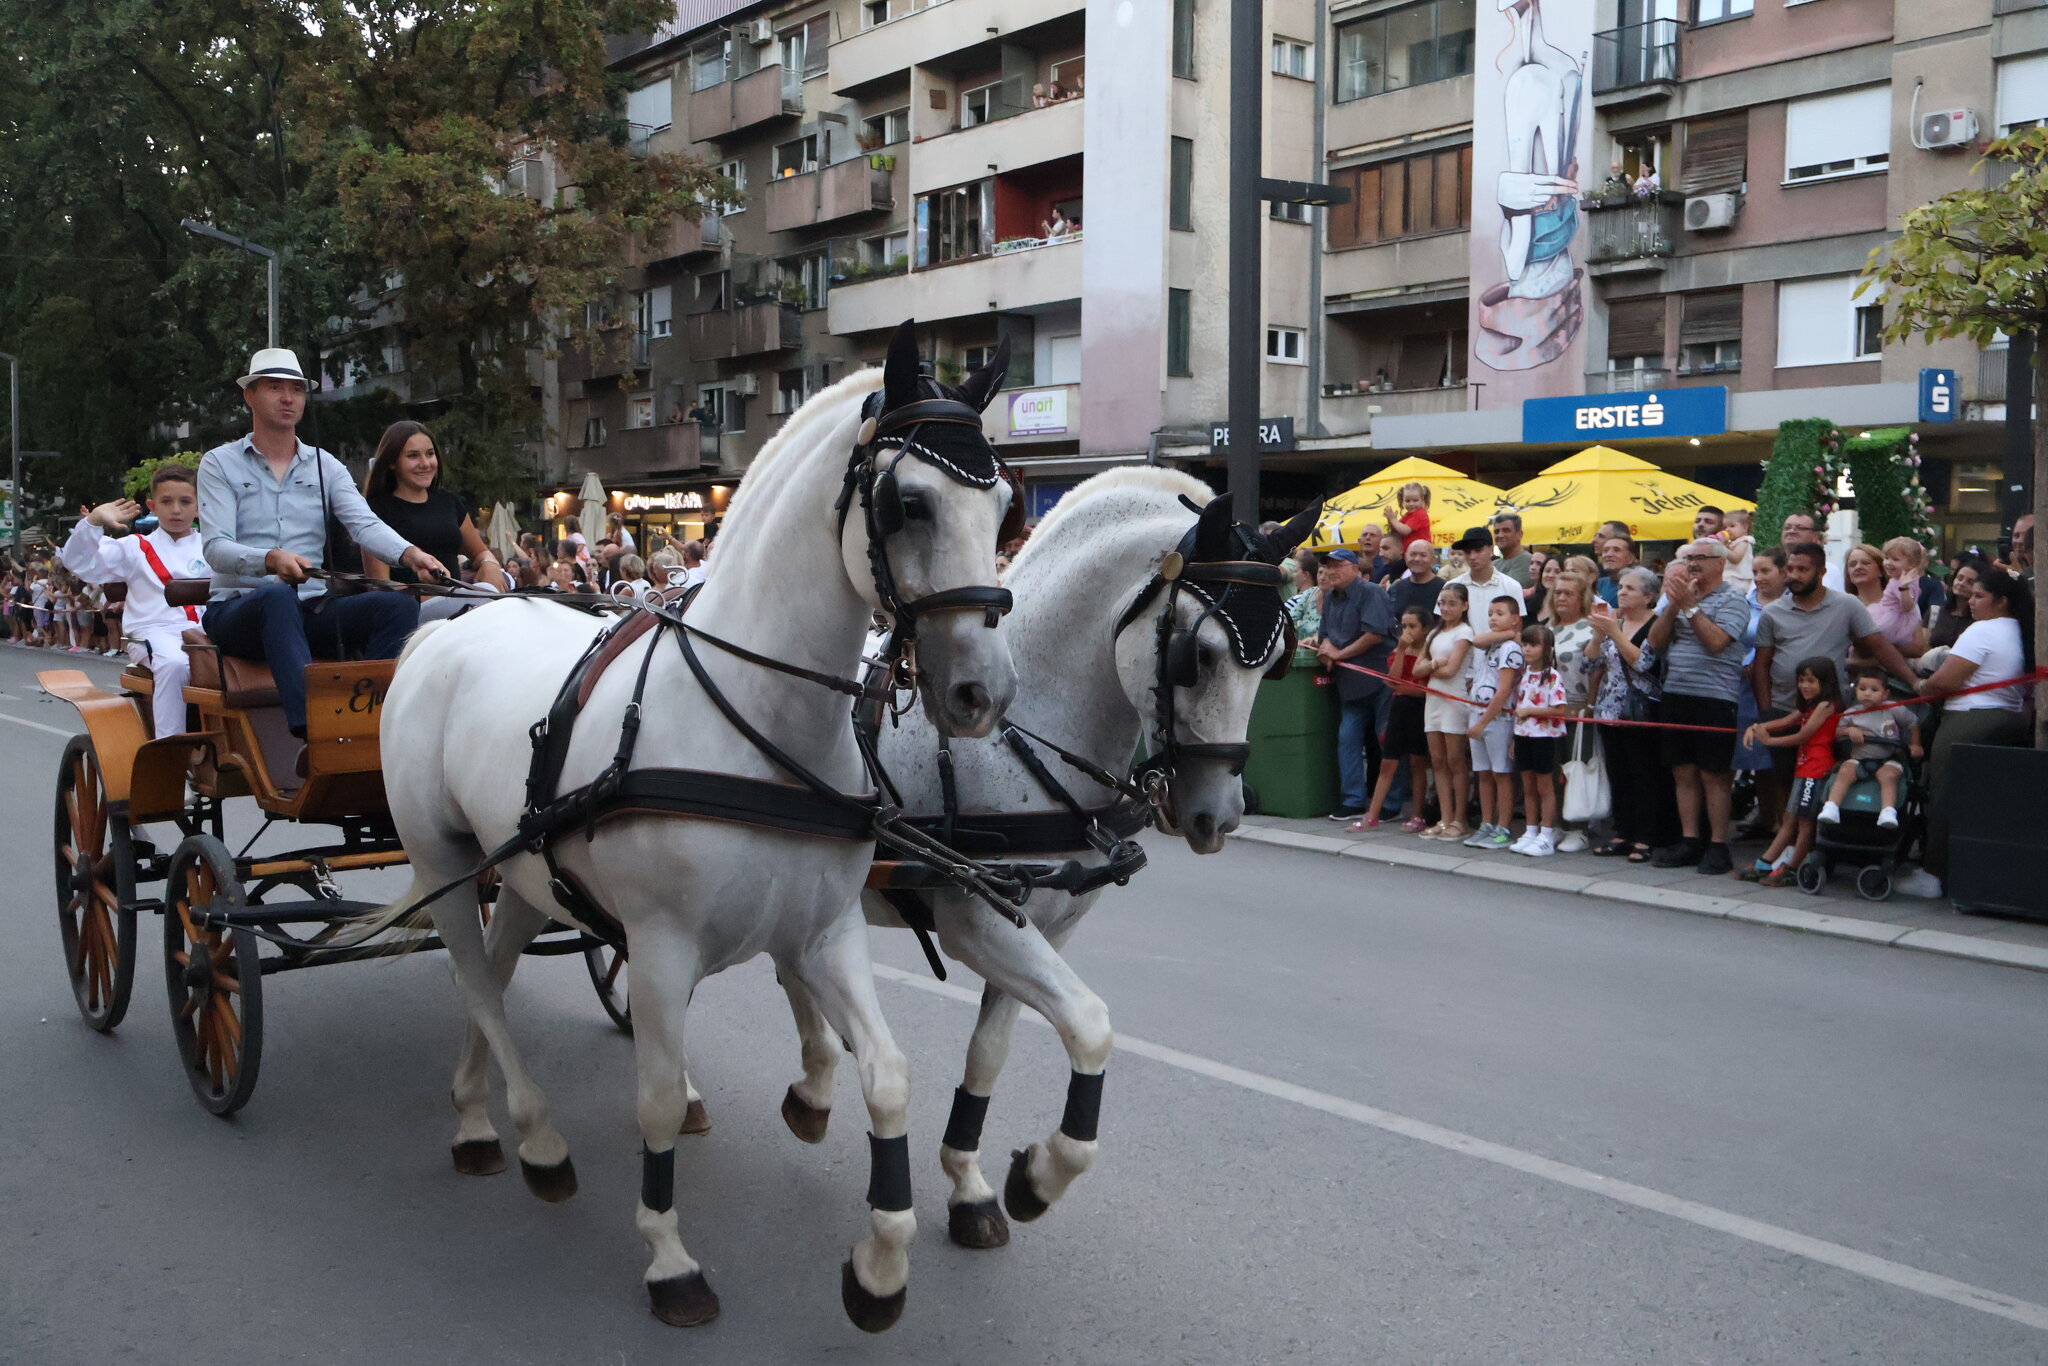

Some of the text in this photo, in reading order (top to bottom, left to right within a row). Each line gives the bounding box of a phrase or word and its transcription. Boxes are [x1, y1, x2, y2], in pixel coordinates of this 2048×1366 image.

[1021, 397, 1053, 414] unart
[1575, 404, 1640, 430] ERSTE
[1213, 424, 1281, 446] PERA
[1629, 491, 1706, 515] Jelen
